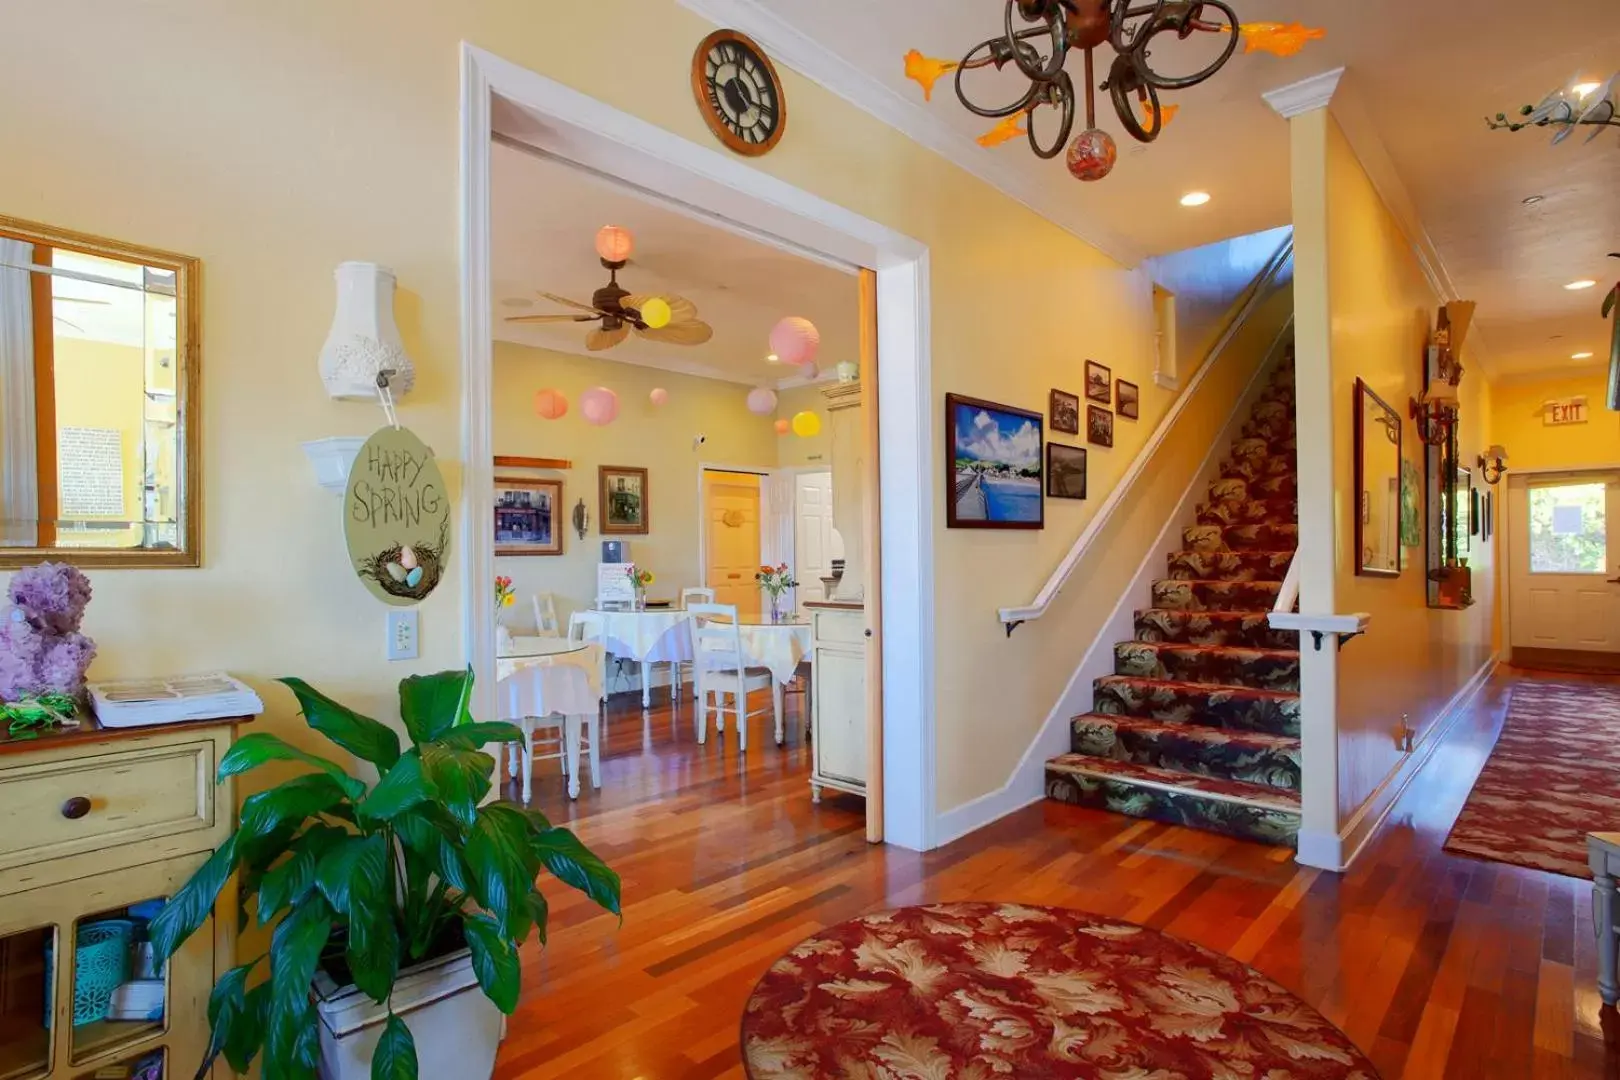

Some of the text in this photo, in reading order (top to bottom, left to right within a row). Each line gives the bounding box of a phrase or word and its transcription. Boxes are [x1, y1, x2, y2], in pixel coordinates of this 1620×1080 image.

[1552, 403, 1582, 422] EXIT
[367, 444, 428, 488] HAPPY
[352, 479, 442, 529] SPRING
